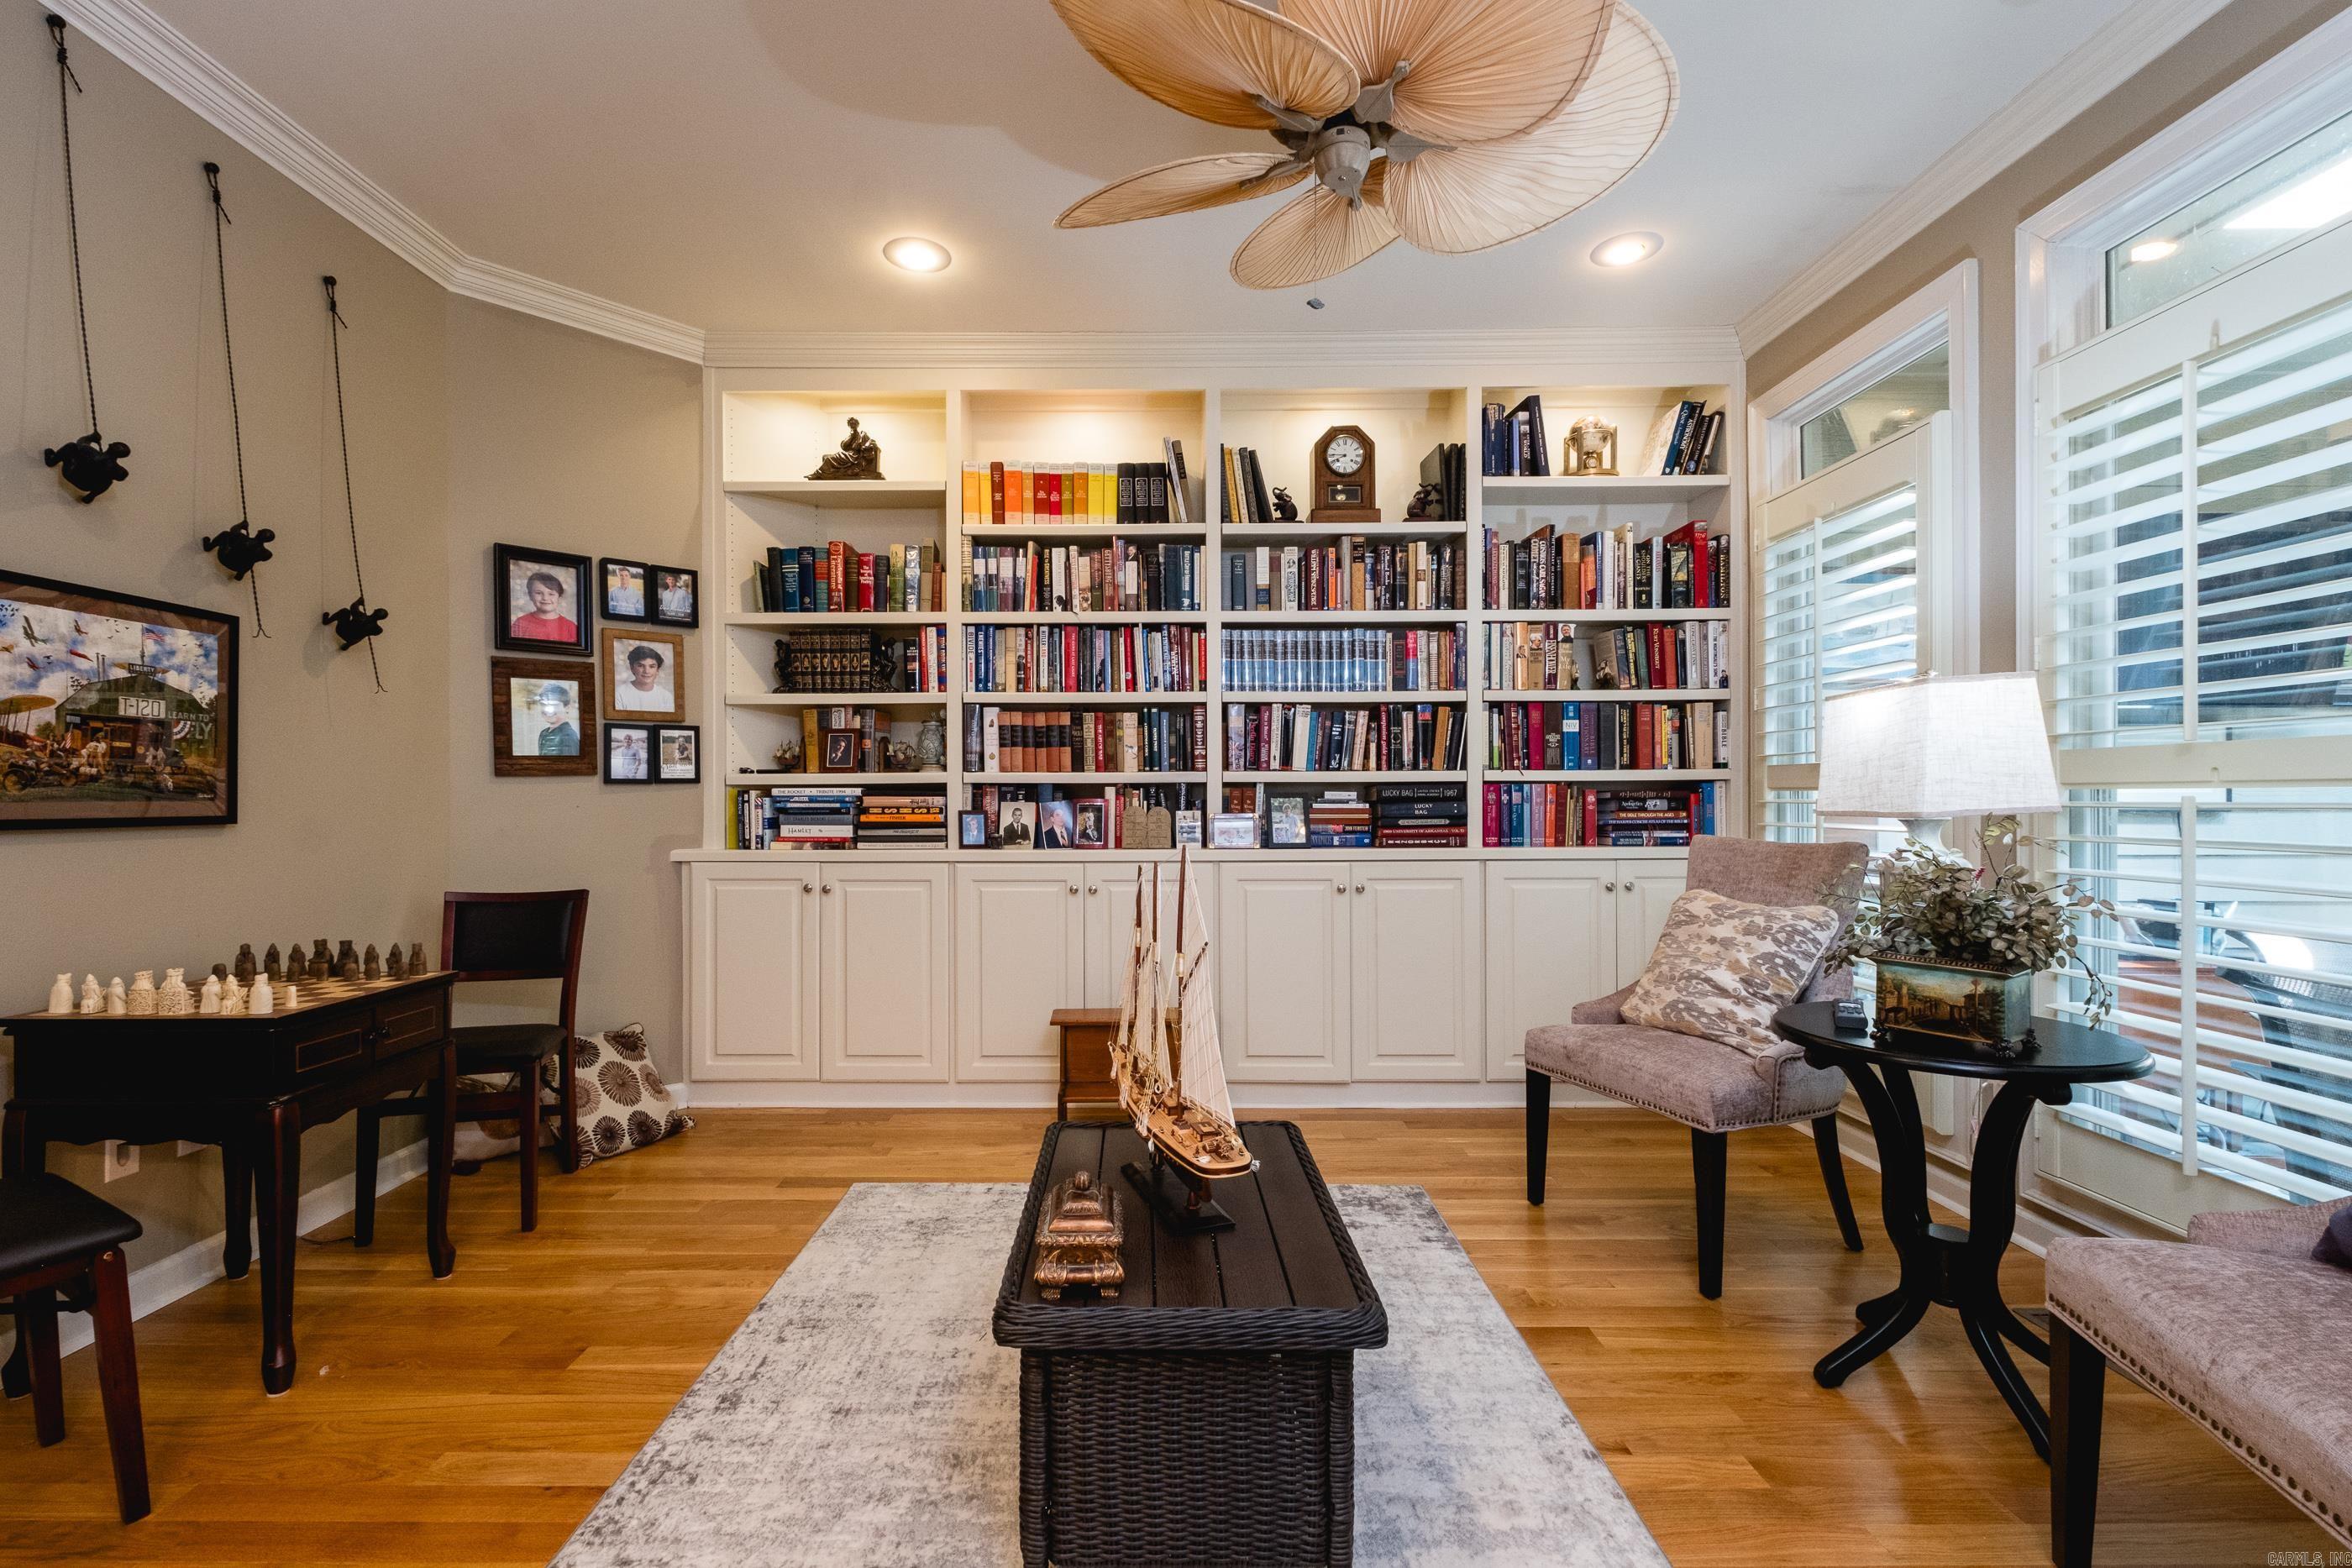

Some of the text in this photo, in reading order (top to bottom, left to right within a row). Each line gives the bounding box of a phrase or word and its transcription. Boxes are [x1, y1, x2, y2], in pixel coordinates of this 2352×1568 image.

[1679, 418, 1693, 451] ASTRONOMY
[1105, 549, 1114, 584] GETTYSBURG
[1646, 554, 1651, 564] ON
[1546, 639, 1557, 674] EISENHOWER
[129, 664, 155, 673] LIBERTY
[121, 697, 160, 717] T-120
[168, 711, 196, 721] LEARN
[1383, 789, 1457, 797] LUCKY BAG 1967
